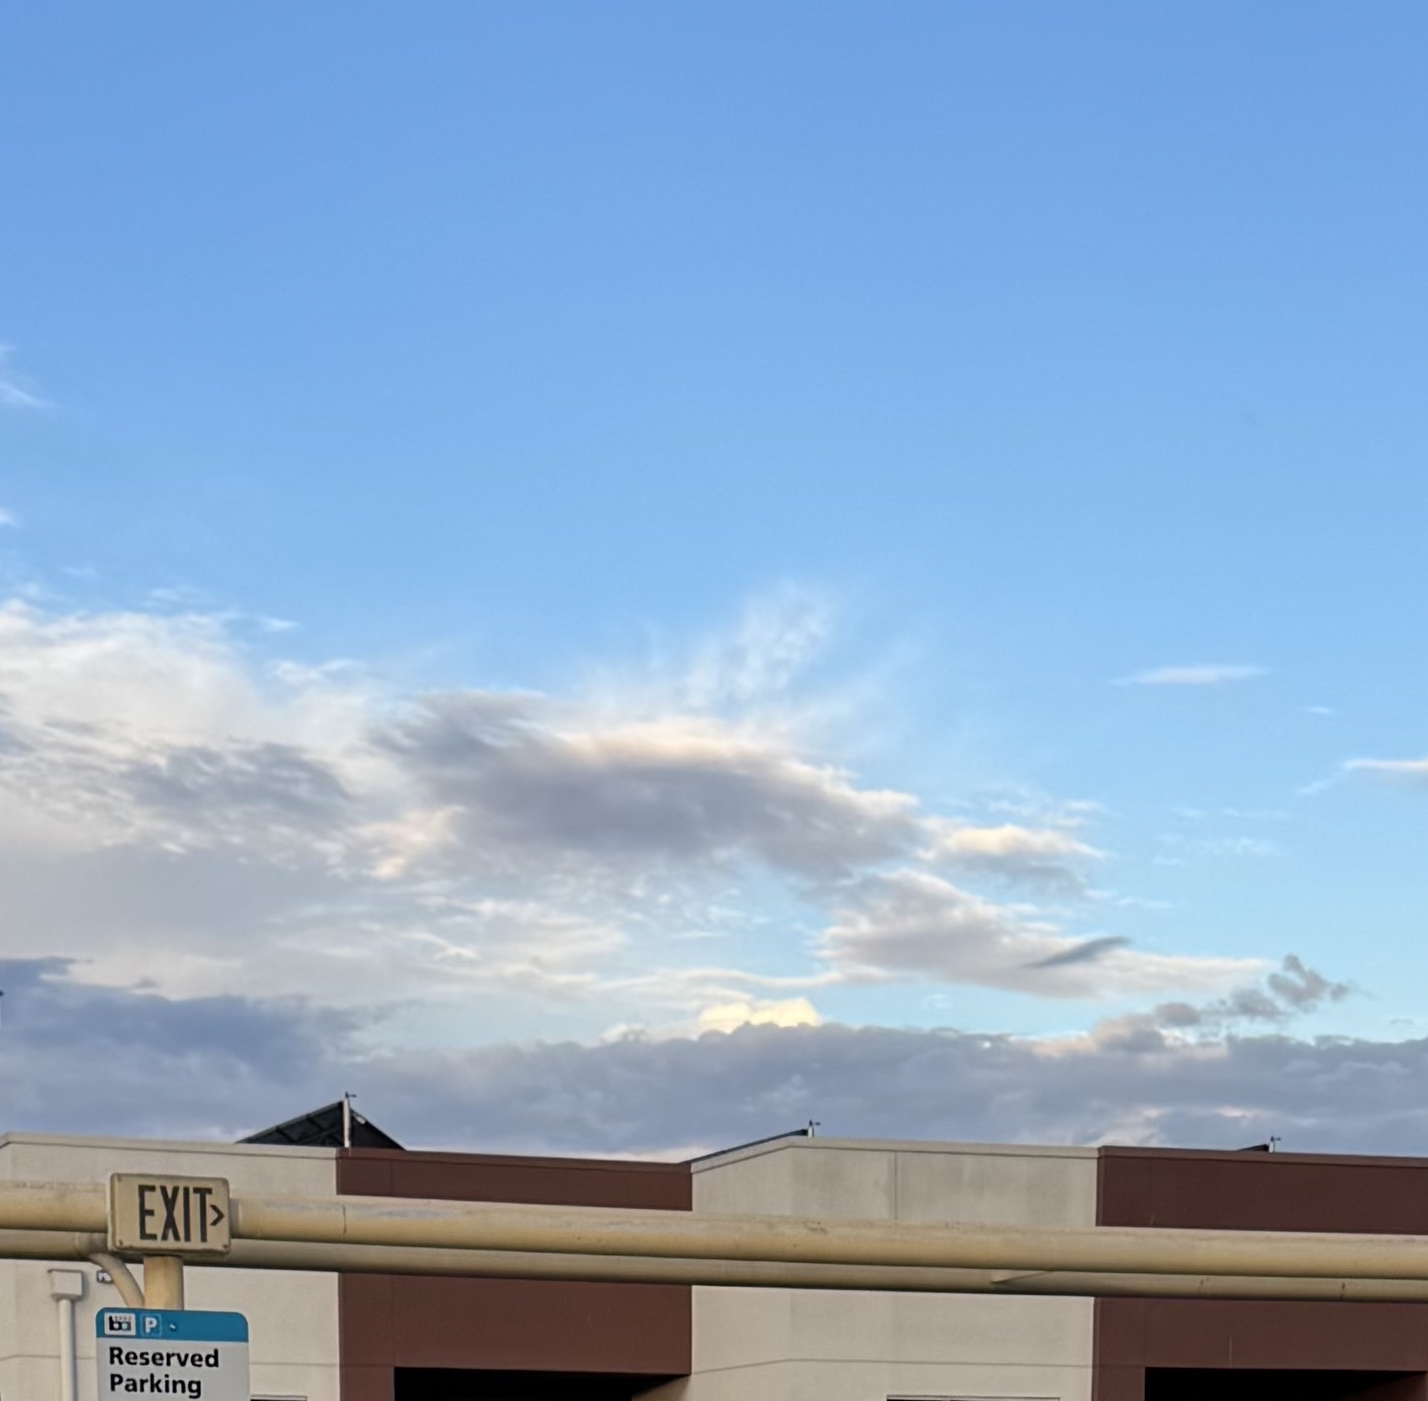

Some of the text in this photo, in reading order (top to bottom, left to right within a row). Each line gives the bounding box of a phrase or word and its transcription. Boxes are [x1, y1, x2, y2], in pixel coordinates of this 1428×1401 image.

[138, 1184, 213, 1243] EXIT
[109, 1346, 220, 1368] Reserved
[110, 1373, 202, 1399] Parking
